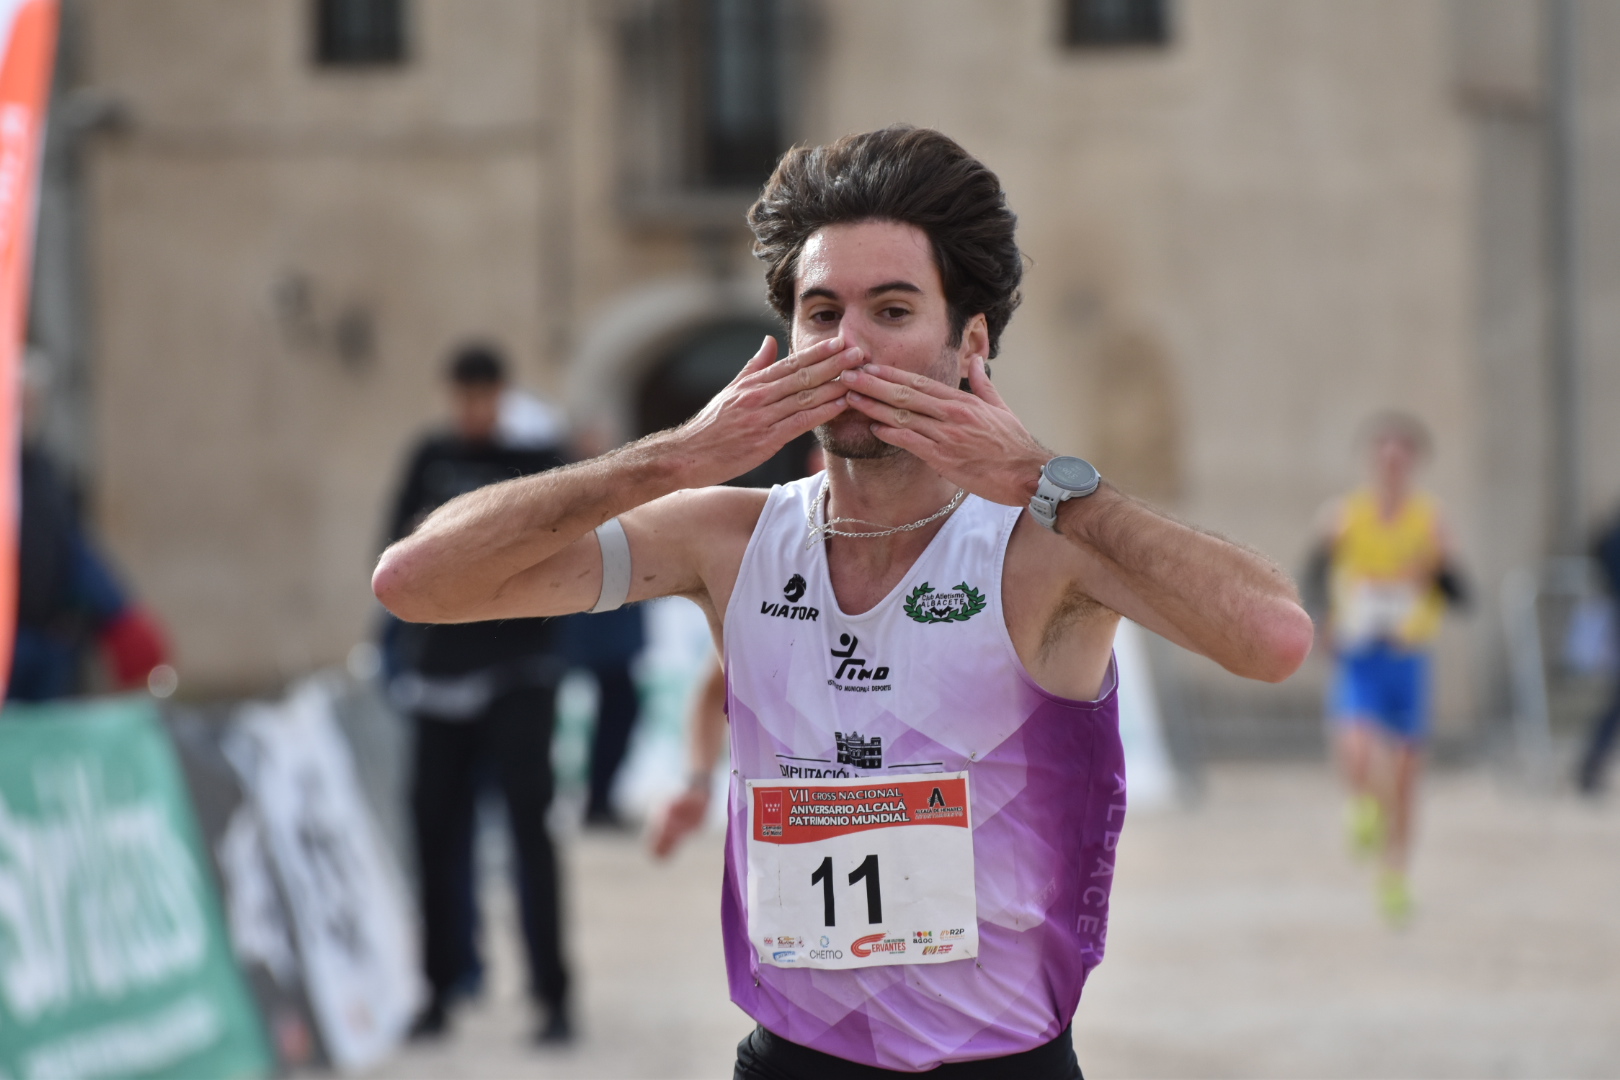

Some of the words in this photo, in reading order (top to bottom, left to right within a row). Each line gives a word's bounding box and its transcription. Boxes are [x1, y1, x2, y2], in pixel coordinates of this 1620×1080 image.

[921, 599, 965, 608] ALBACETE
[935, 592, 965, 600] Atletismo
[760, 601, 819, 622] VIATOR
[789, 789, 809, 802] VII
[811, 791, 837, 801] CROSS
[838, 788, 903, 800] NACIONAL
[790, 804, 855, 815] ANIVERSARIO
[856, 799, 906, 814] ALCALÁ
[788, 814, 851, 826] PATRIMONIO
[851, 811, 910, 824] MUNDIAL
[1076, 772, 1127, 962] ALBACET
[811, 854, 882, 927] 11
